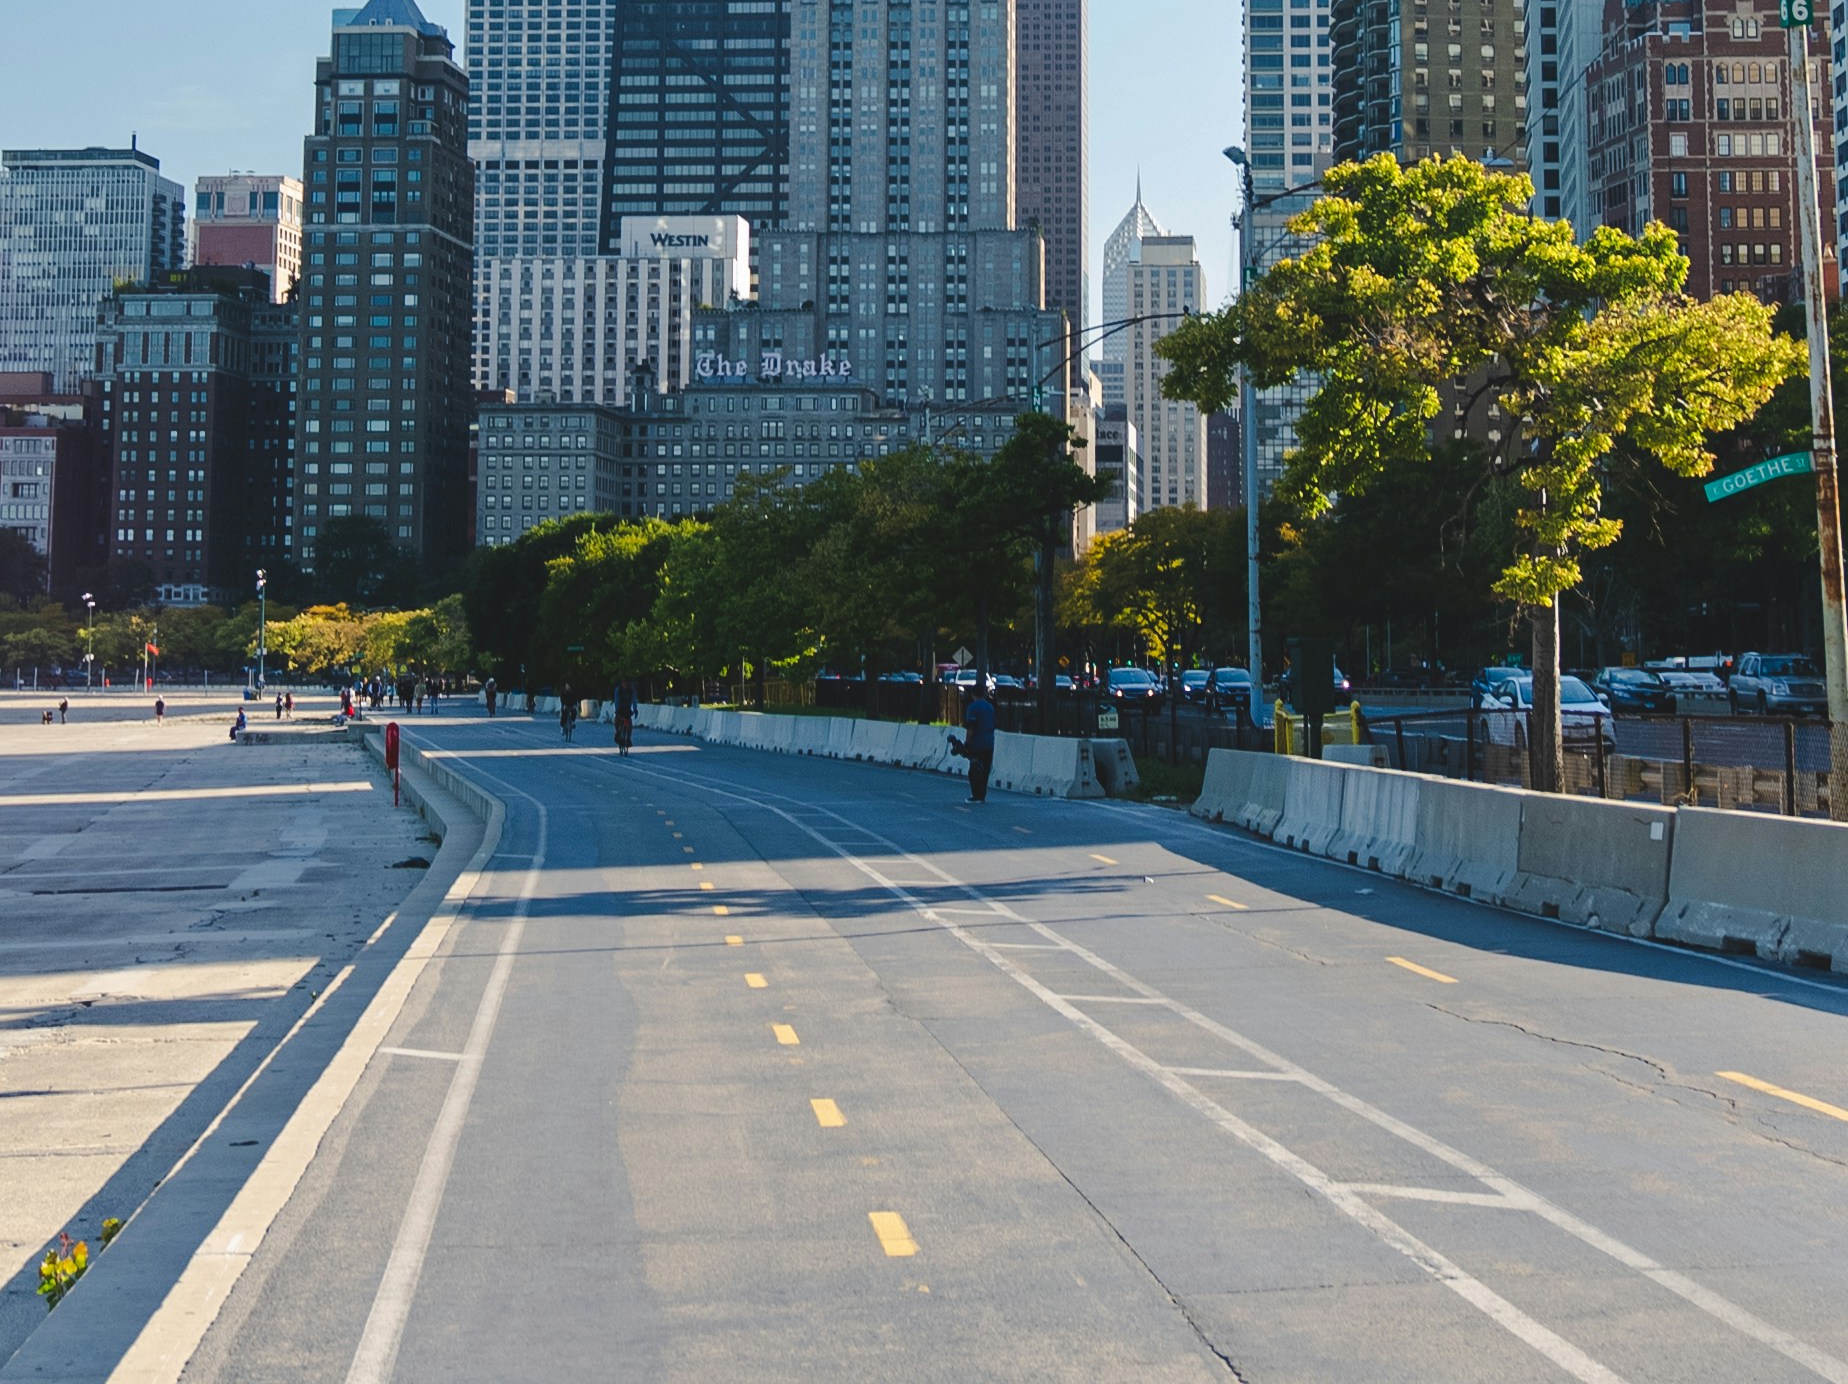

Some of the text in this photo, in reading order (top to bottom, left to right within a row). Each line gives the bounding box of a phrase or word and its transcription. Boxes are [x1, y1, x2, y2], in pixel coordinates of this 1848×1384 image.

[650, 233, 708, 246] WESTIN
[697, 352, 852, 378] The Drake
[1722, 458, 1793, 493] GOETHE
